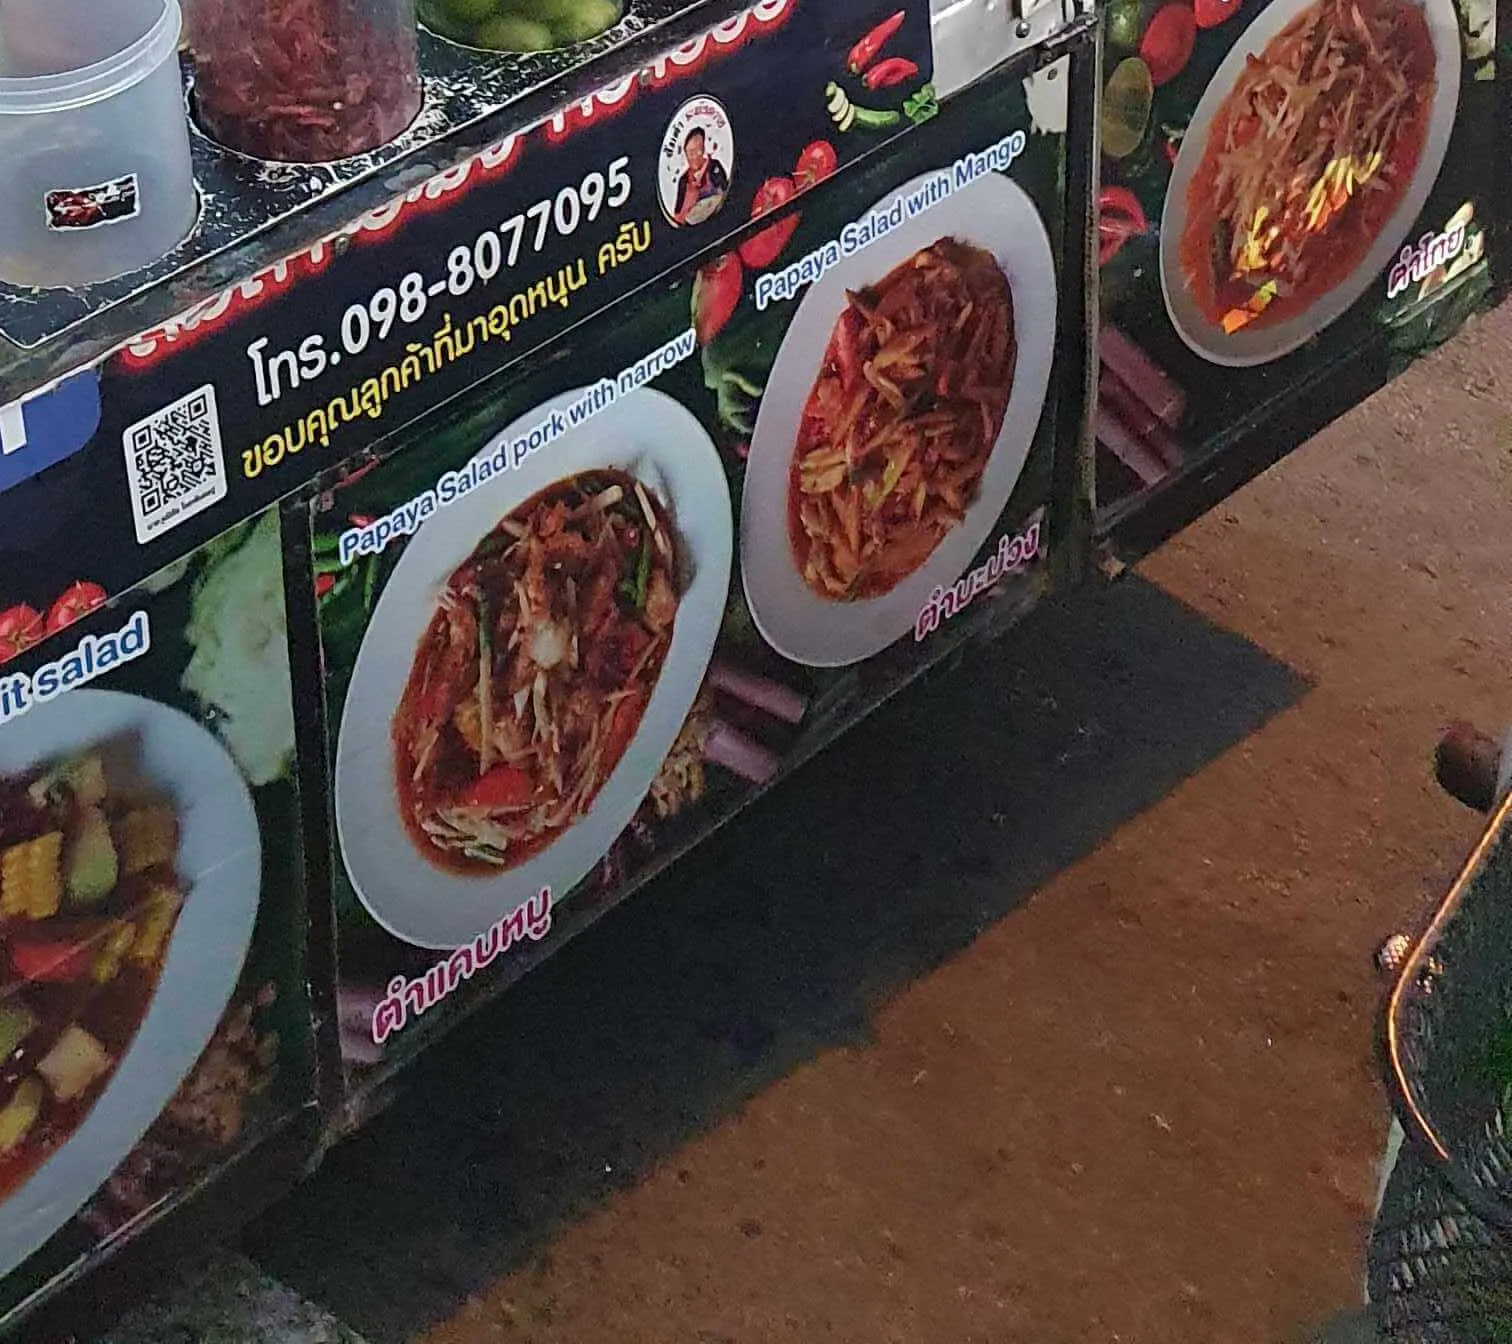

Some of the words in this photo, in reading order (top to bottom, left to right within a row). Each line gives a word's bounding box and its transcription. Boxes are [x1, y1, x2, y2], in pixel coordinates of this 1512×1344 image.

[756, 244, 839, 310] Papaya
[840, 200, 902, 257] Salad
[907, 177, 951, 217] with
[954, 131, 1026, 190] Mango
[242, 265, 586, 479] ขอบคุณลูกค้าที่มาอุดหนุน
[597, 221, 651, 278] ครับ
[340, 492, 435, 564] Papaya
[439, 442, 507, 503] Salad
[512, 418, 565, 468] pork
[569, 375, 615, 426] with
[619, 328, 696, 395] narrow
[31, 611, 149, 704] salad
[372, 886, 552, 1044] ตำแคบหมู
